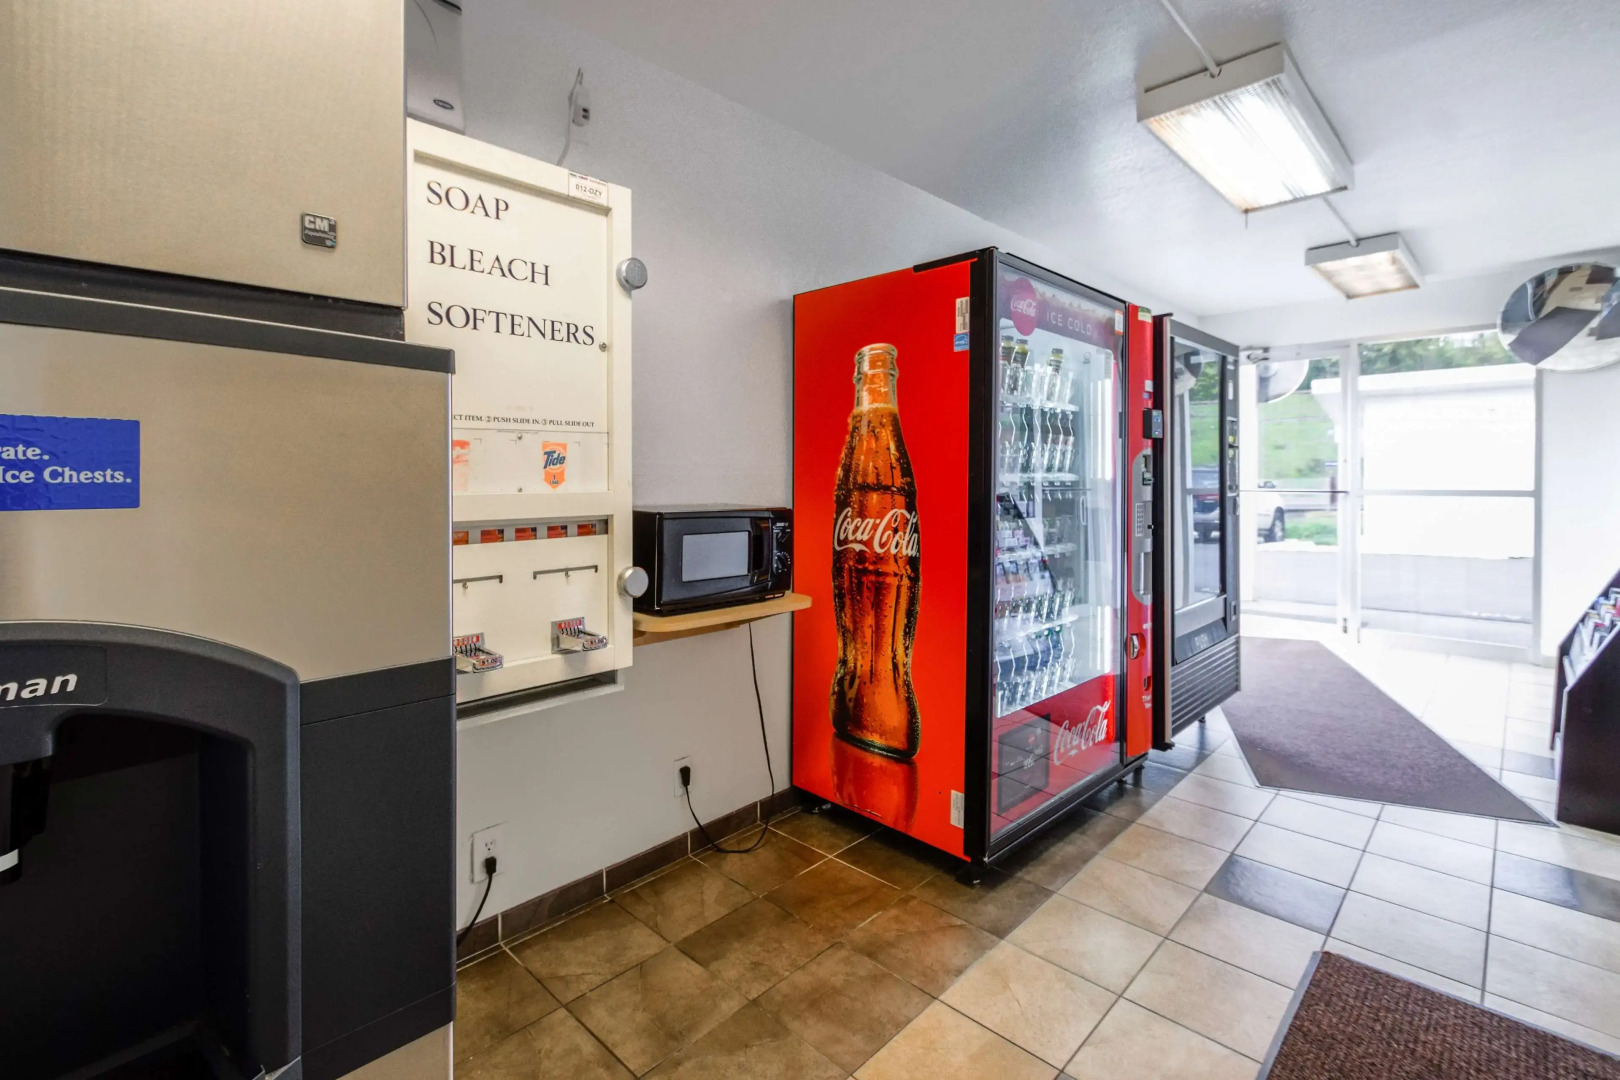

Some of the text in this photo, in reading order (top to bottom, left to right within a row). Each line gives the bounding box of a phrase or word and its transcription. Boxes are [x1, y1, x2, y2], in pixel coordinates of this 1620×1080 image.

[426, 180, 509, 221] SOAP
[427, 239, 550, 287] BLEACH
[427, 301, 595, 347] SOFTENERS
[1046, 308, 1092, 336] ICE COLD
[493, 416, 511, 424] PUSH
[512, 417, 530, 425] SLIDE
[0, 444, 50, 460] ate.
[543, 450, 566, 470] Tide
[43, 466, 132, 484] Chests.
[833, 507, 919, 558] Coca-Cola
[1053, 700, 1111, 766] Coca-Cola
